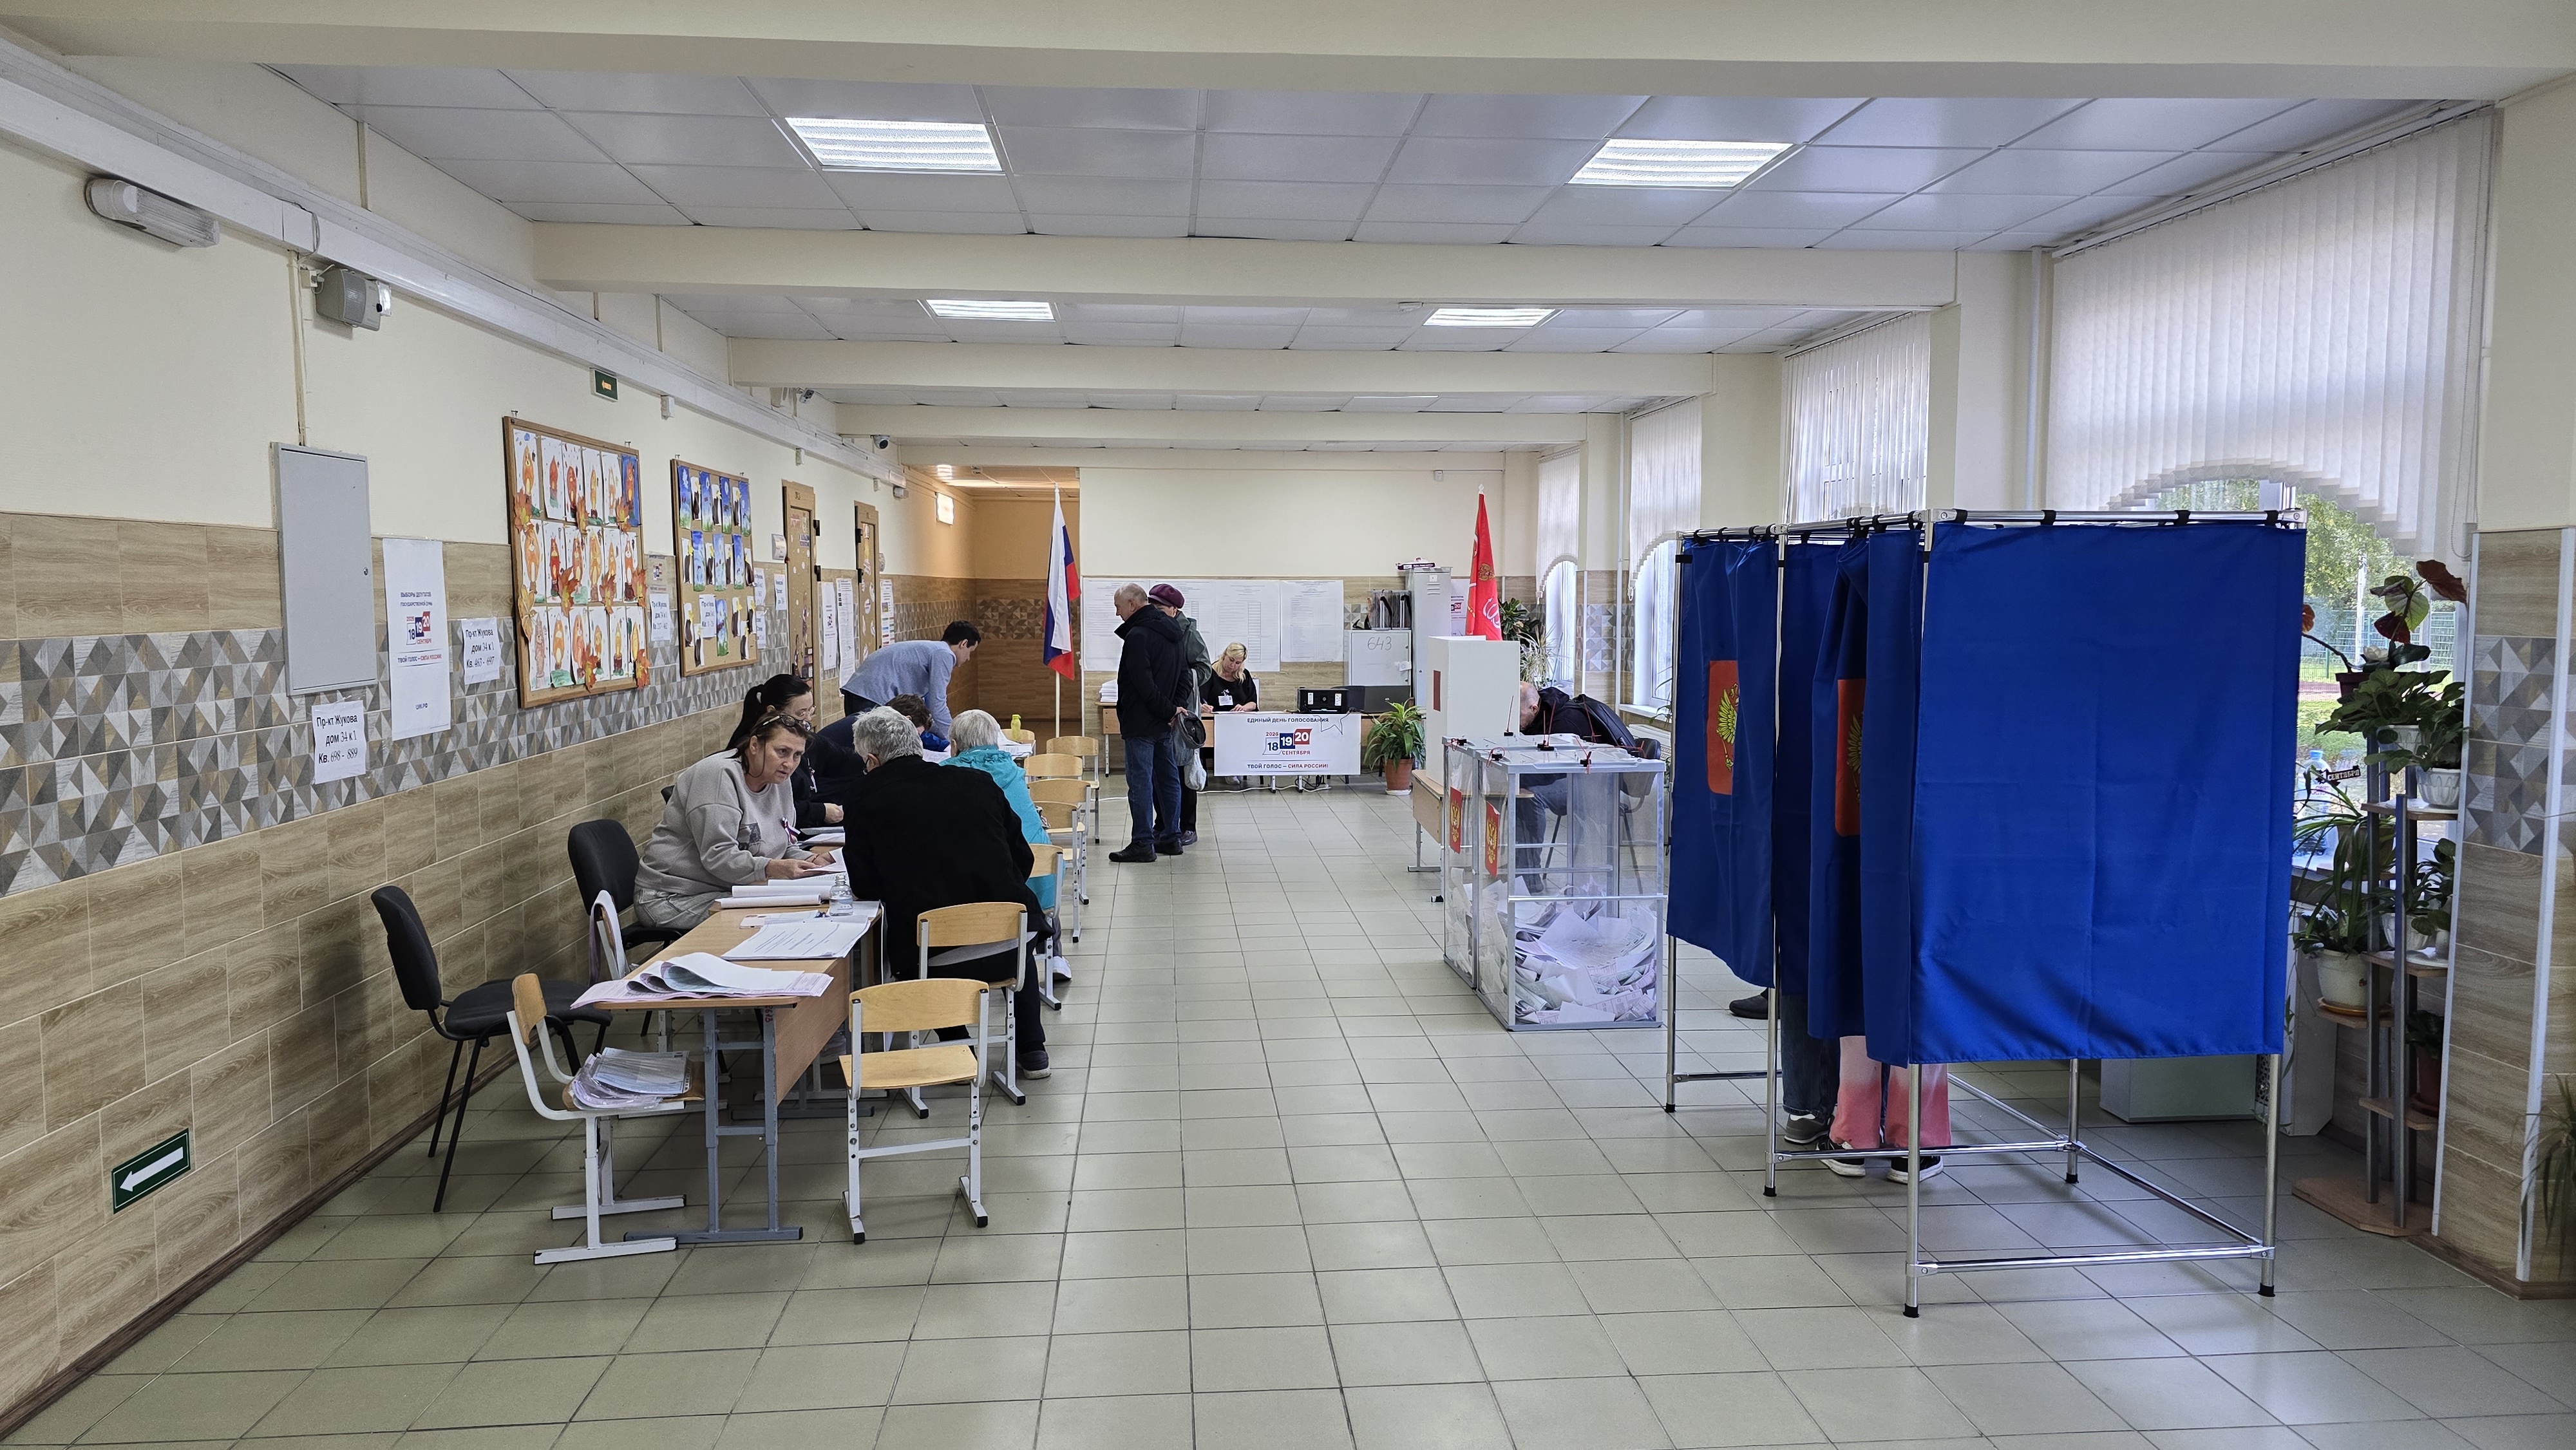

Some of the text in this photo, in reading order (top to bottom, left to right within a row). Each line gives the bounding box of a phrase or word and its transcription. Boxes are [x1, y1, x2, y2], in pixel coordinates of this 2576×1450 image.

[408, 616, 430, 640] 18 19 20
[466, 628, 493, 639] Пр-кт Жукова
[471, 645, 481, 654] дом
[482, 642, 488, 652] 34
[1368, 636, 1392, 650] 643
[486, 657, 495, 665] 697
[317, 715, 357, 729] Пр-кт Жукова
[326, 735, 339, 747] дом
[341, 731, 348, 742] 34
[354, 730, 357, 740] 1
[1267, 732, 1309, 751] 18 19 20
[319, 753, 330, 764] Кв.
[330, 750, 341, 762] 698
[347, 748, 358, 759] 889
[2327, 769, 2360, 781] СЕНТЯБРЯ
